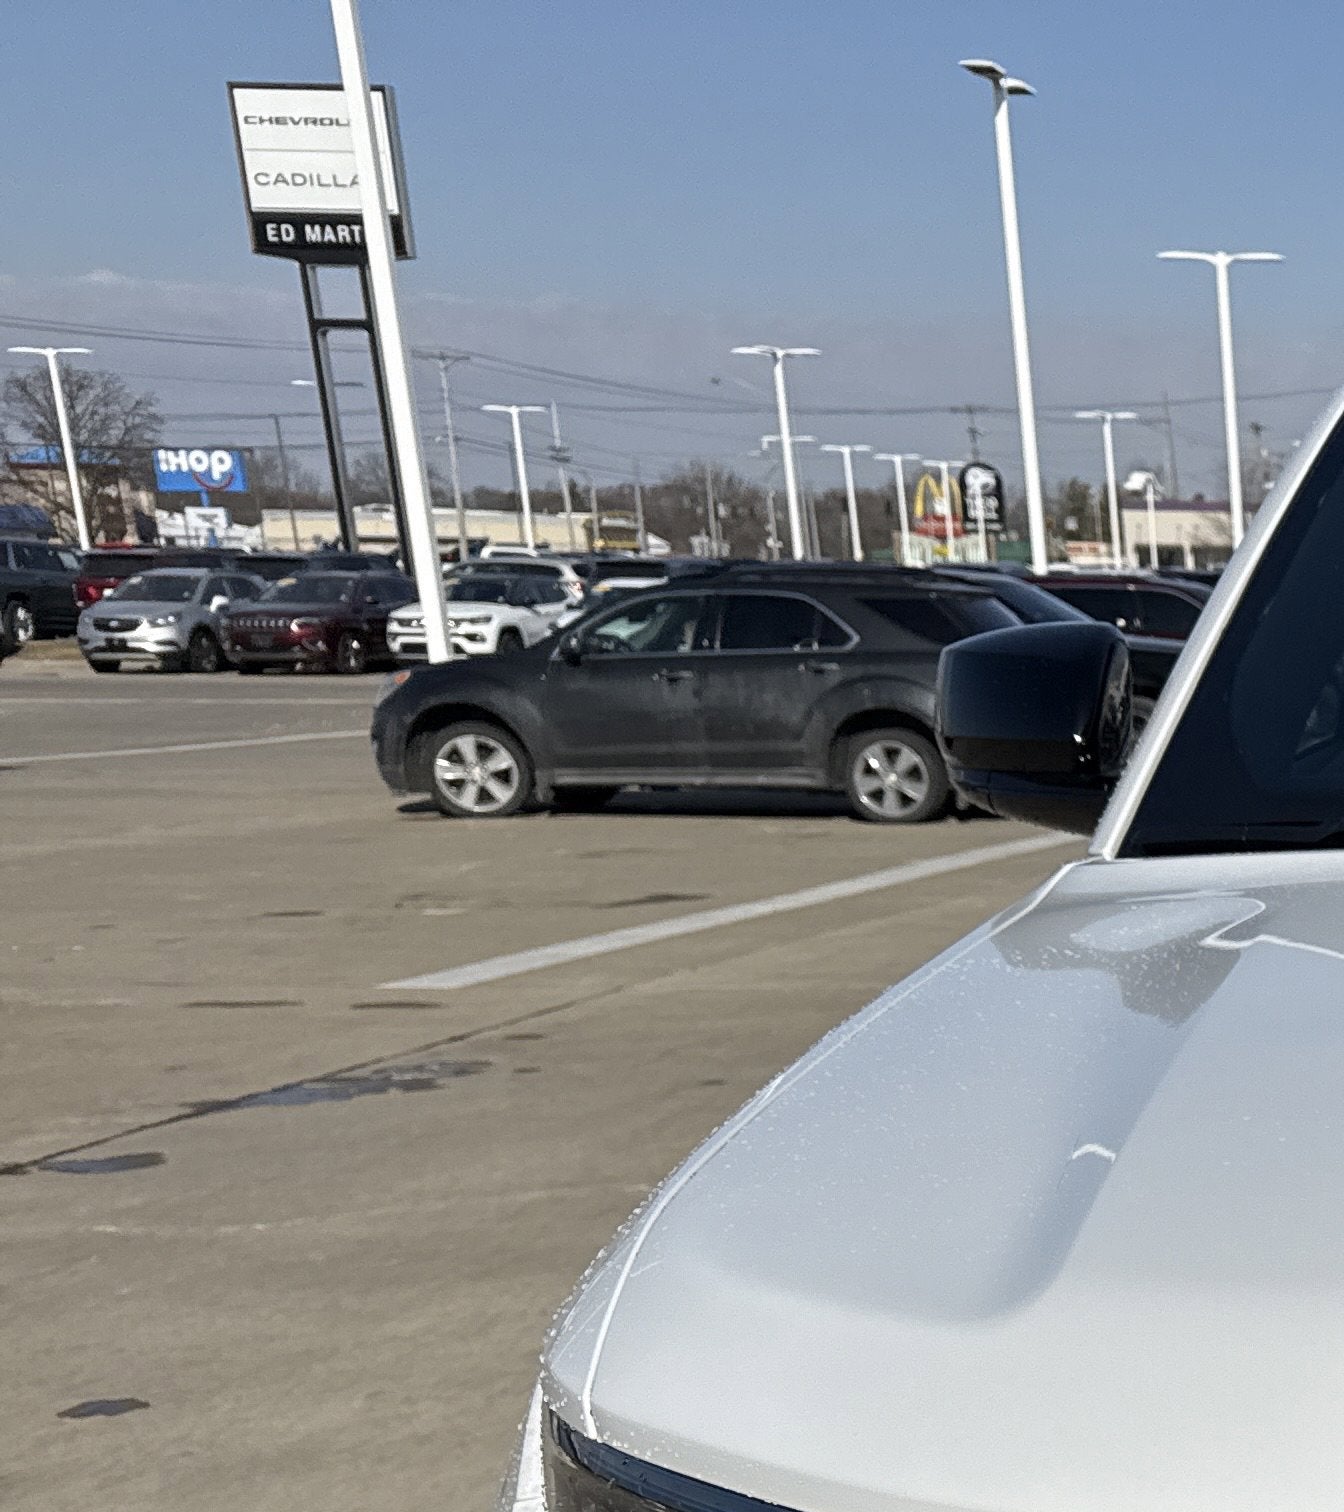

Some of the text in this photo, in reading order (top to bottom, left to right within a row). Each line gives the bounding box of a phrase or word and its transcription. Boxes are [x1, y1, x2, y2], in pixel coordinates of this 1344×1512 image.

[243, 115, 351, 127] CHEVROL
[253, 172, 360, 188] CADILLA
[265, 223, 363, 244] ED MART
